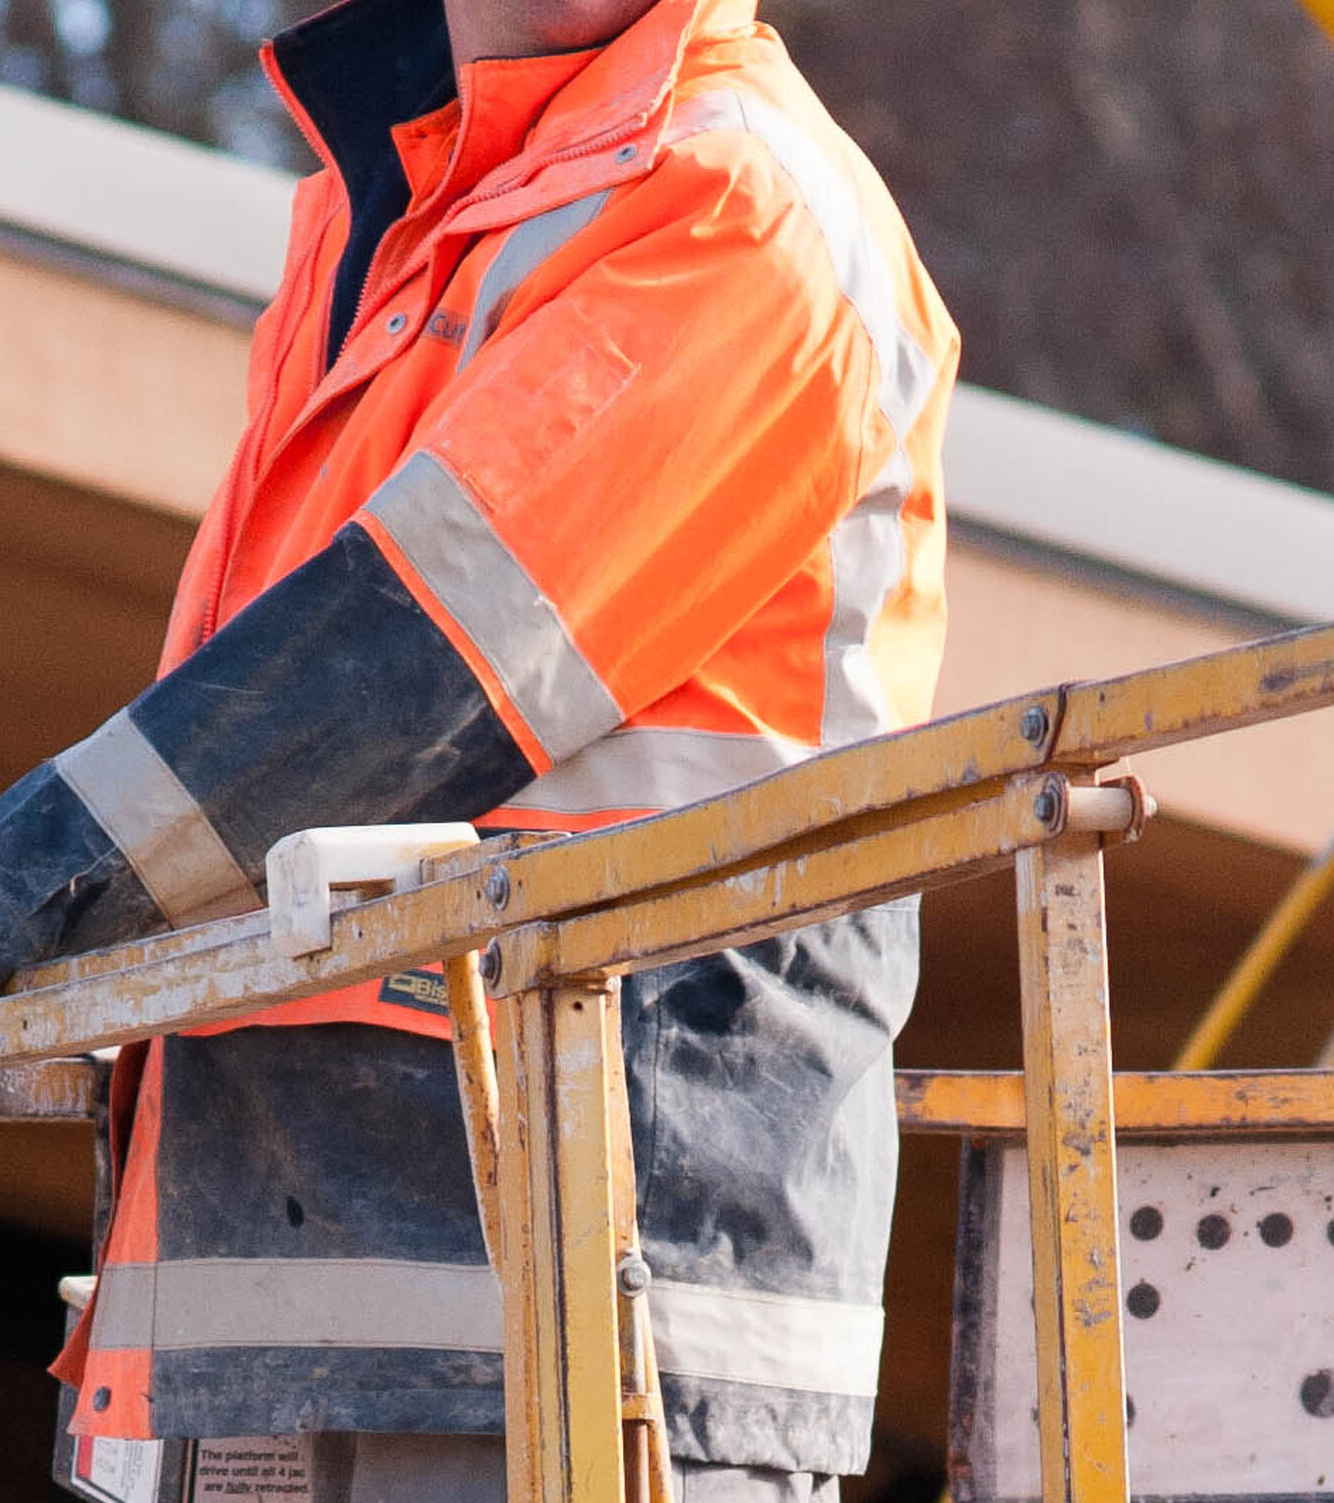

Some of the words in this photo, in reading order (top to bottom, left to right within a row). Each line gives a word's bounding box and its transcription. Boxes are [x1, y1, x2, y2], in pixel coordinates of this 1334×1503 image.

[201, 1449, 222, 1461] The
[225, 1450, 276, 1463] platform
[278, 1450, 299, 1461] will
[199, 1466, 229, 1477] drive
[231, 1466, 258, 1477] until
[261, 1466, 276, 1477] all
[278, 1467, 285, 1477] 4
[288, 1467, 306, 1479] jac
[204, 1483, 223, 1492] are
[225, 1481, 251, 1494] fully
